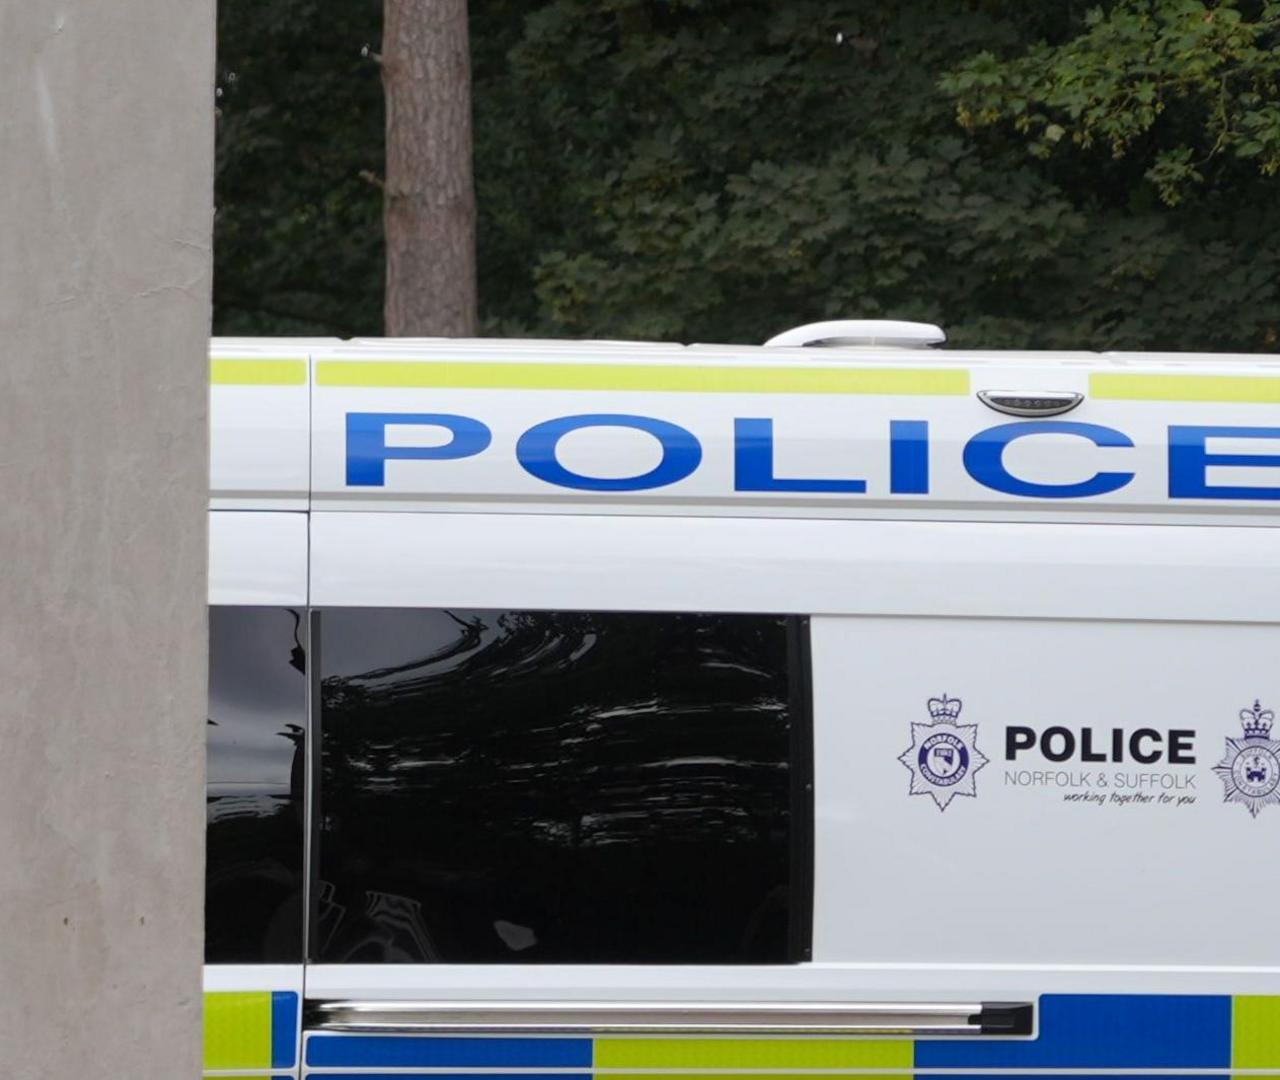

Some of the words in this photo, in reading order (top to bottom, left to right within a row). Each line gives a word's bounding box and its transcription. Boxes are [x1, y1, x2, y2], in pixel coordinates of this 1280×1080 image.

[923, 734, 964, 750] NORFOLK
[1005, 726, 1196, 765] POLICE
[1004, 770, 1092, 788] NORFOLK
[1096, 772, 1109, 788] &
[1113, 772, 1197, 790] SUFFOLK
[1063, 790, 1106, 807] working
[1109, 791, 1155, 807] together
[1157, 791, 1175, 804] for
[1176, 795, 1197, 808] you
